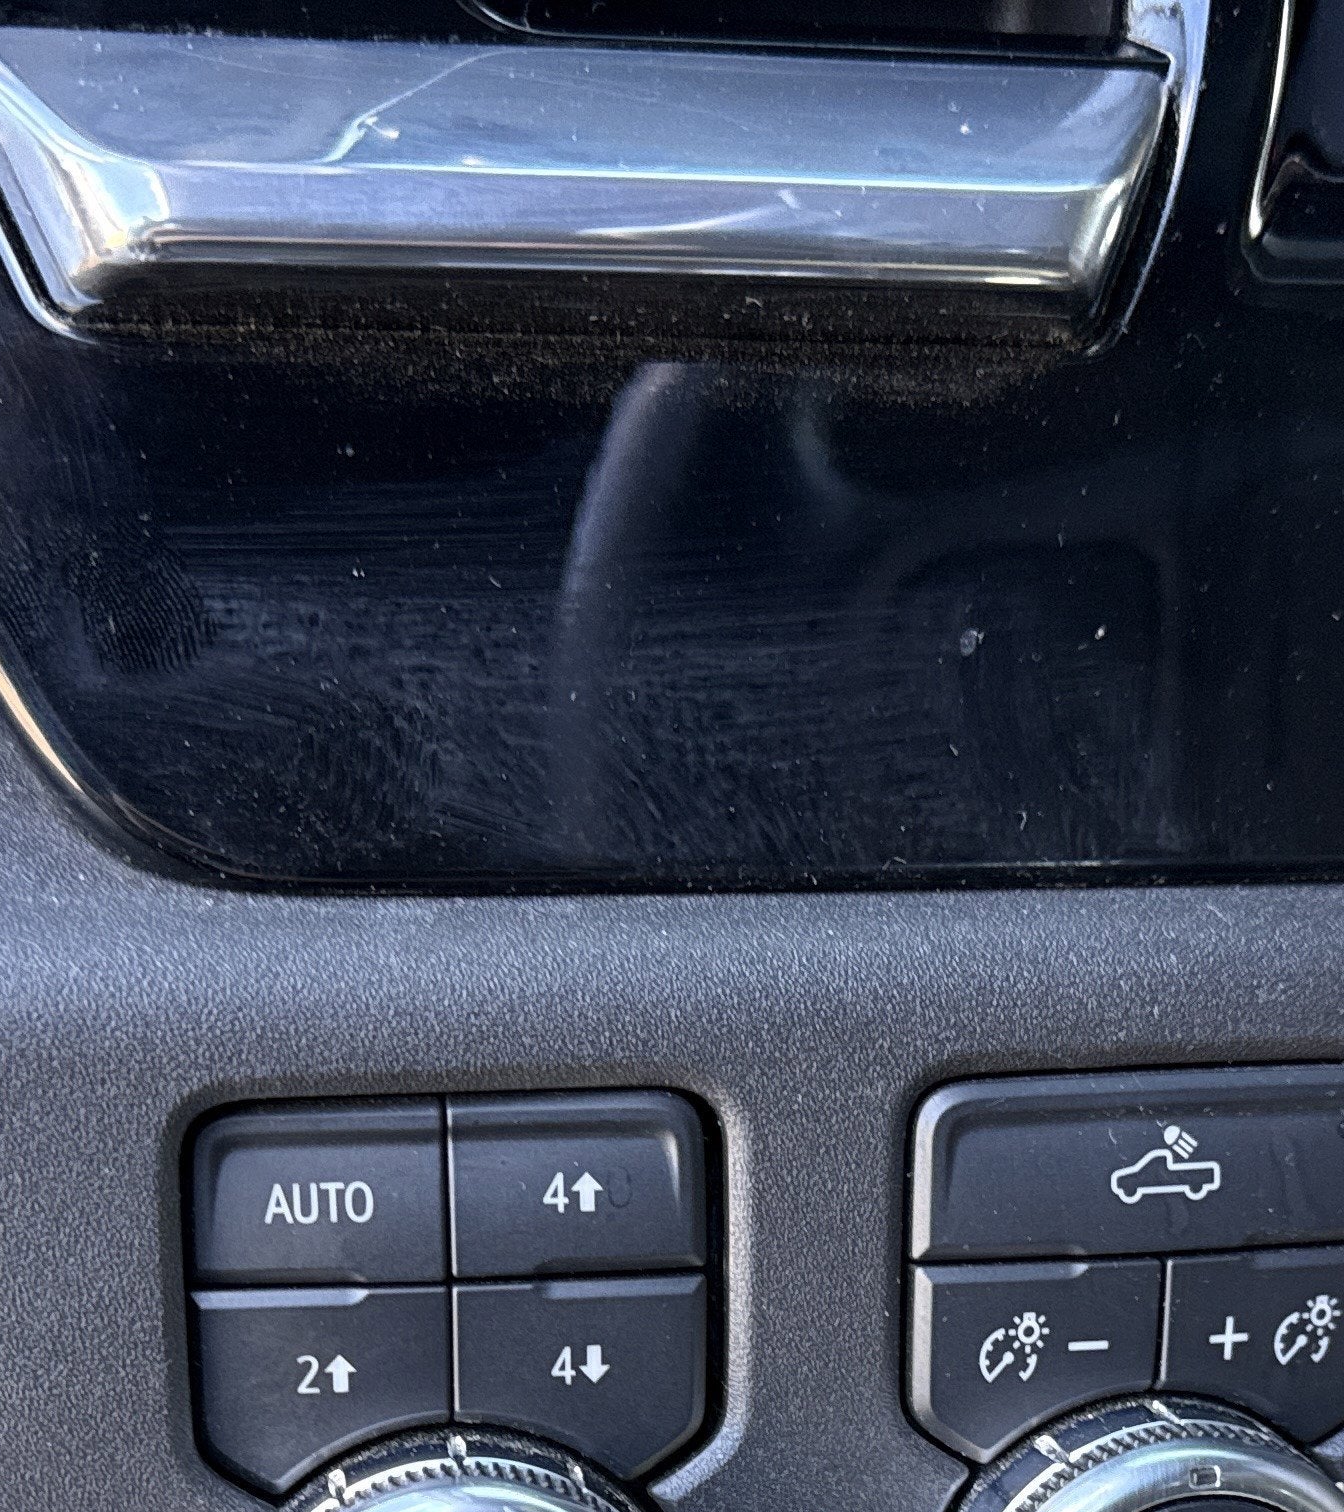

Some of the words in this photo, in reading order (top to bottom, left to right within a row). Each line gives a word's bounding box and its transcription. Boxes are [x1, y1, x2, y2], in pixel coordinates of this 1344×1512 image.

[264, 1180, 374, 1225] AUTO
[542, 1171, 569, 1214] 4
[296, 1354, 321, 1395] 2
[550, 1345, 576, 1386] 4
